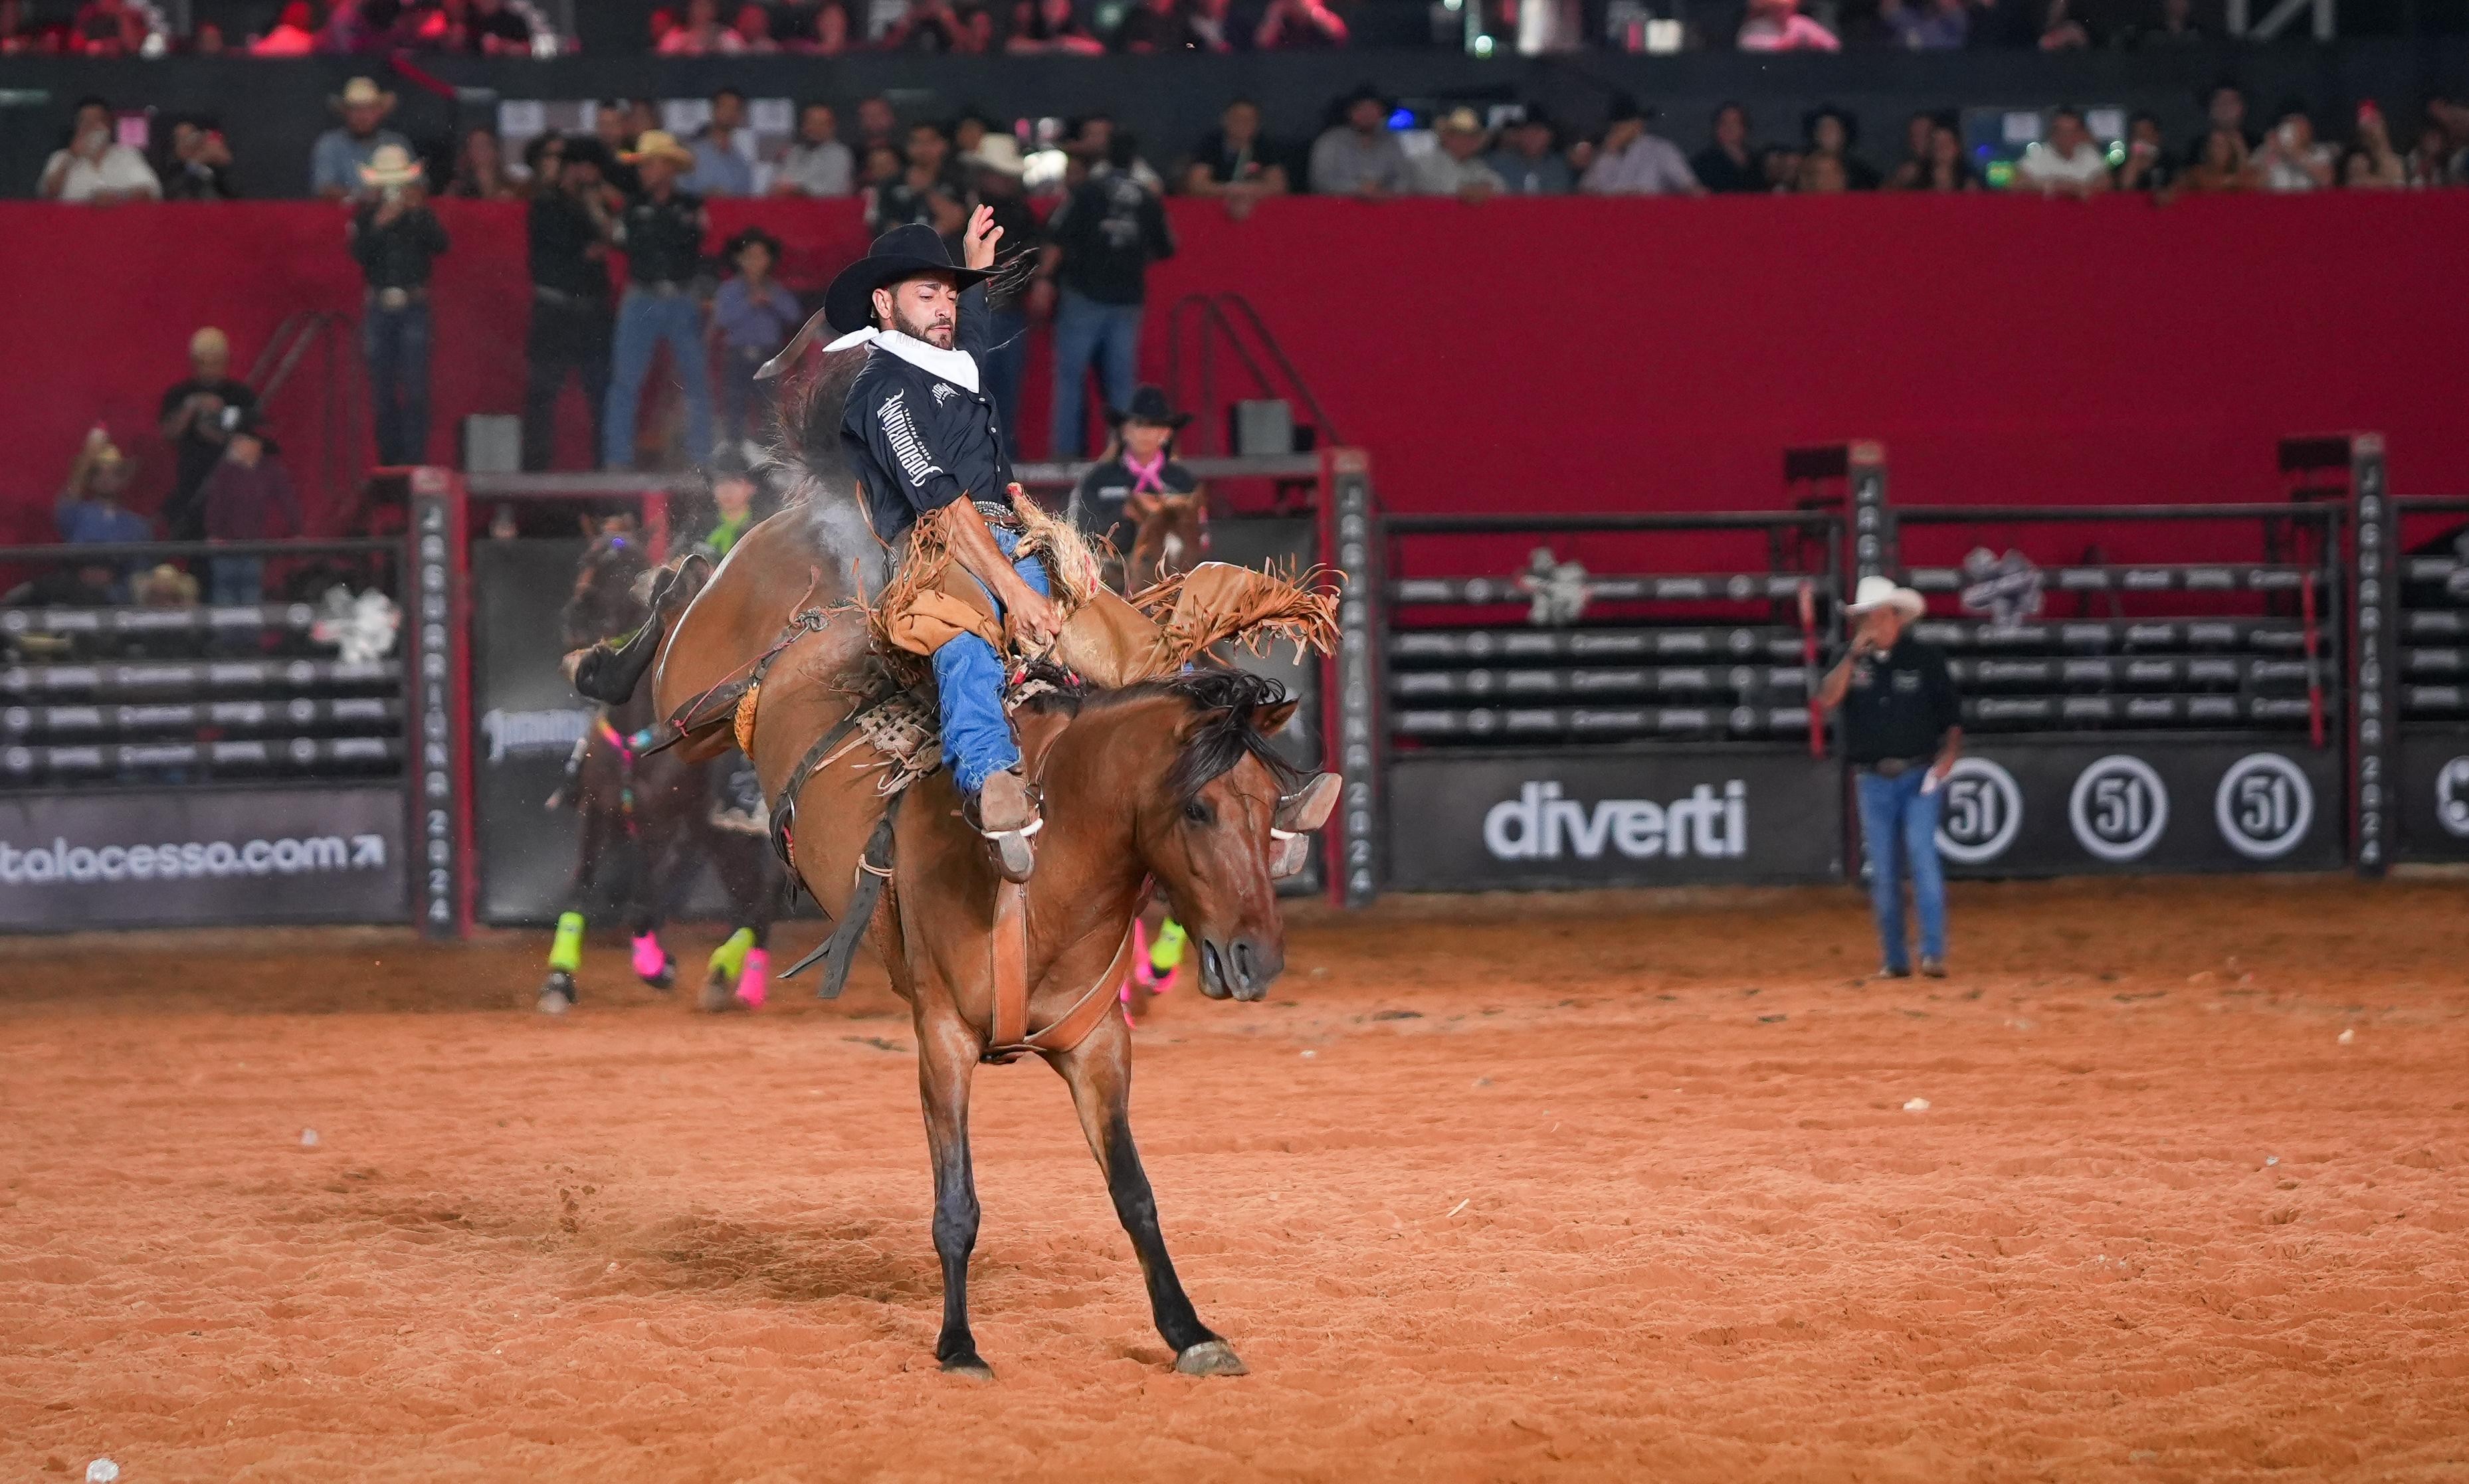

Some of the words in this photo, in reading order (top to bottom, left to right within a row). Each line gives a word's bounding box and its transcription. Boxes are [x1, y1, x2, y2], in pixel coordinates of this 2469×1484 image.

[1484, 781, 1745, 858] diverti
[1948, 777, 1998, 838] 51
[2094, 776, 2145, 837] 51
[2240, 775, 2290, 834] 51
[1349, 782, 1372, 892] 2024
